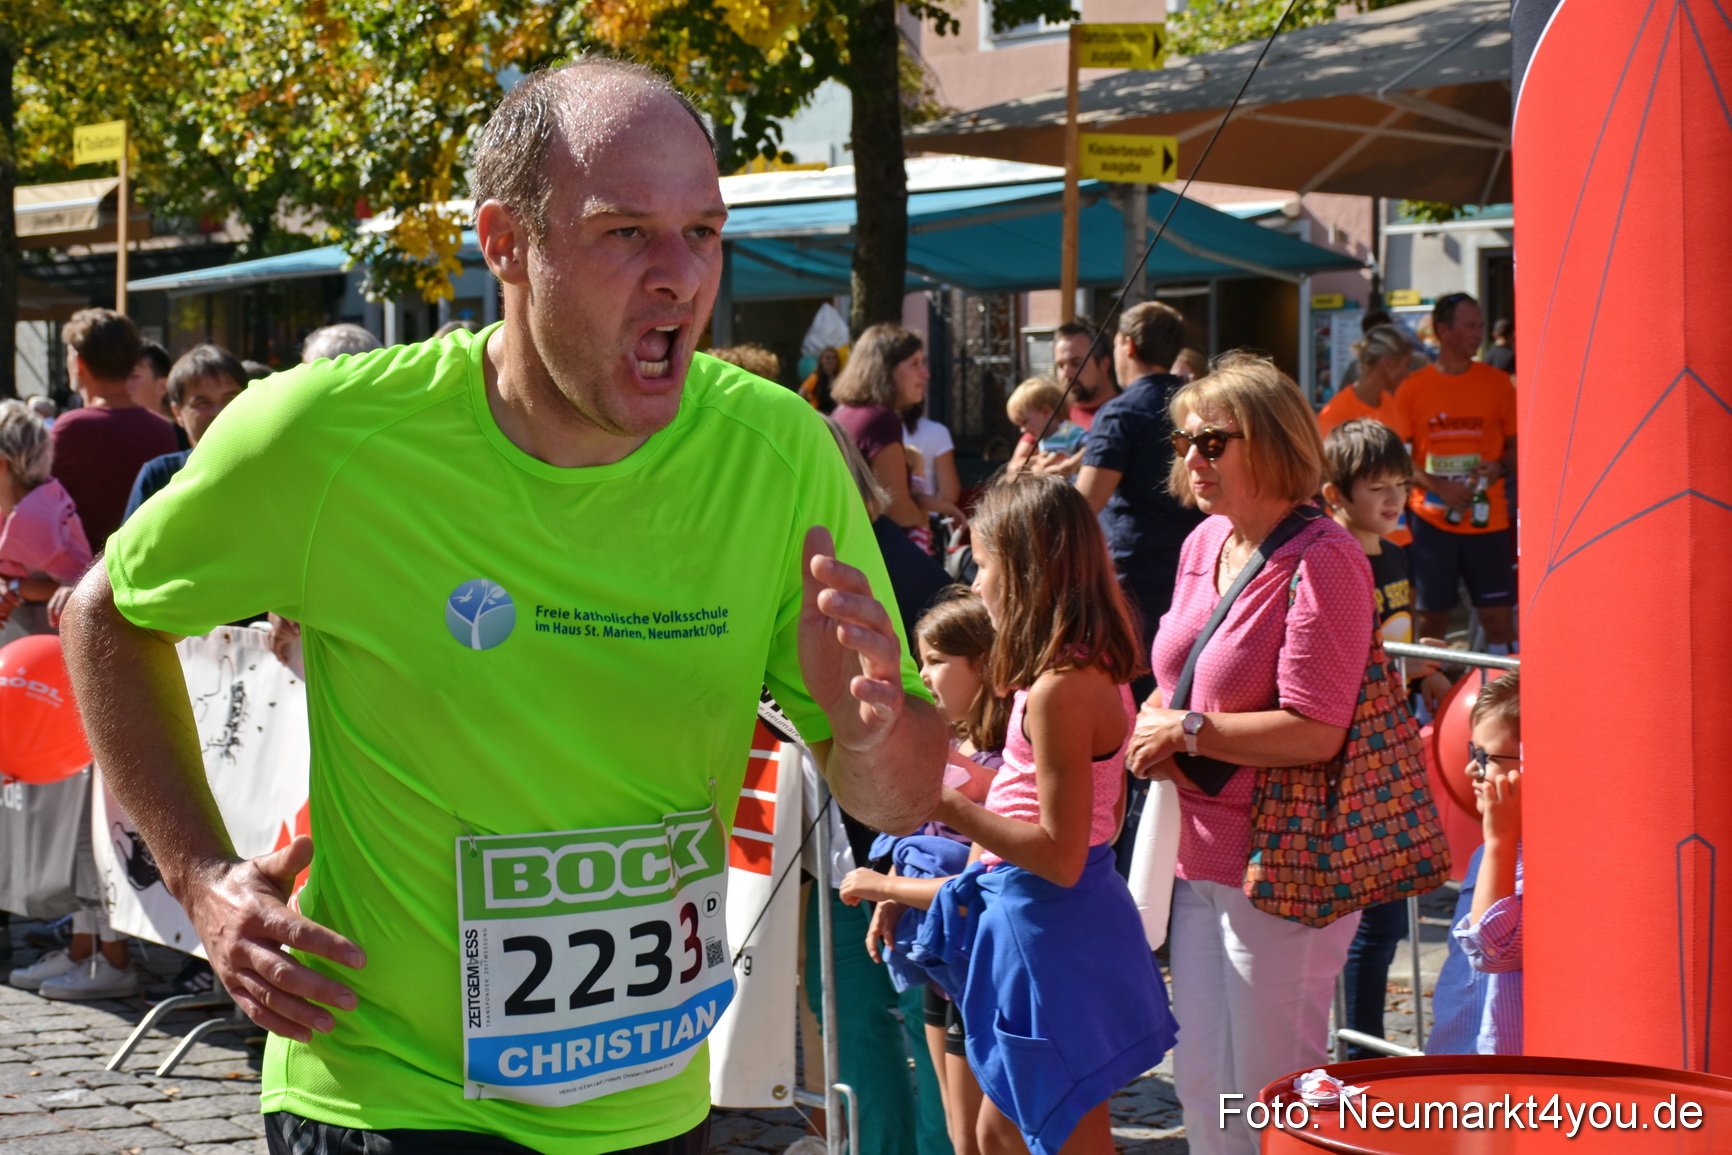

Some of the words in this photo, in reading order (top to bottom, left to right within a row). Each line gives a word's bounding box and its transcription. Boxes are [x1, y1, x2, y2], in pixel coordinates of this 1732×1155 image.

[535, 605, 570, 620] Freie
[574, 608, 650, 625] katholische
[652, 606, 729, 624] Volksschule
[535, 620, 550, 632] im
[553, 622, 581, 637] Haus
[584, 624, 600, 637] St.
[603, 625, 646, 641] Marien,
[648, 621, 730, 640] Neumarkt/Opf.
[484, 819, 712, 909] BOCK
[706, 898, 717, 912] D
[502, 902, 702, 1016] 2233
[498, 1000, 717, 1078] CHRISTIAN
